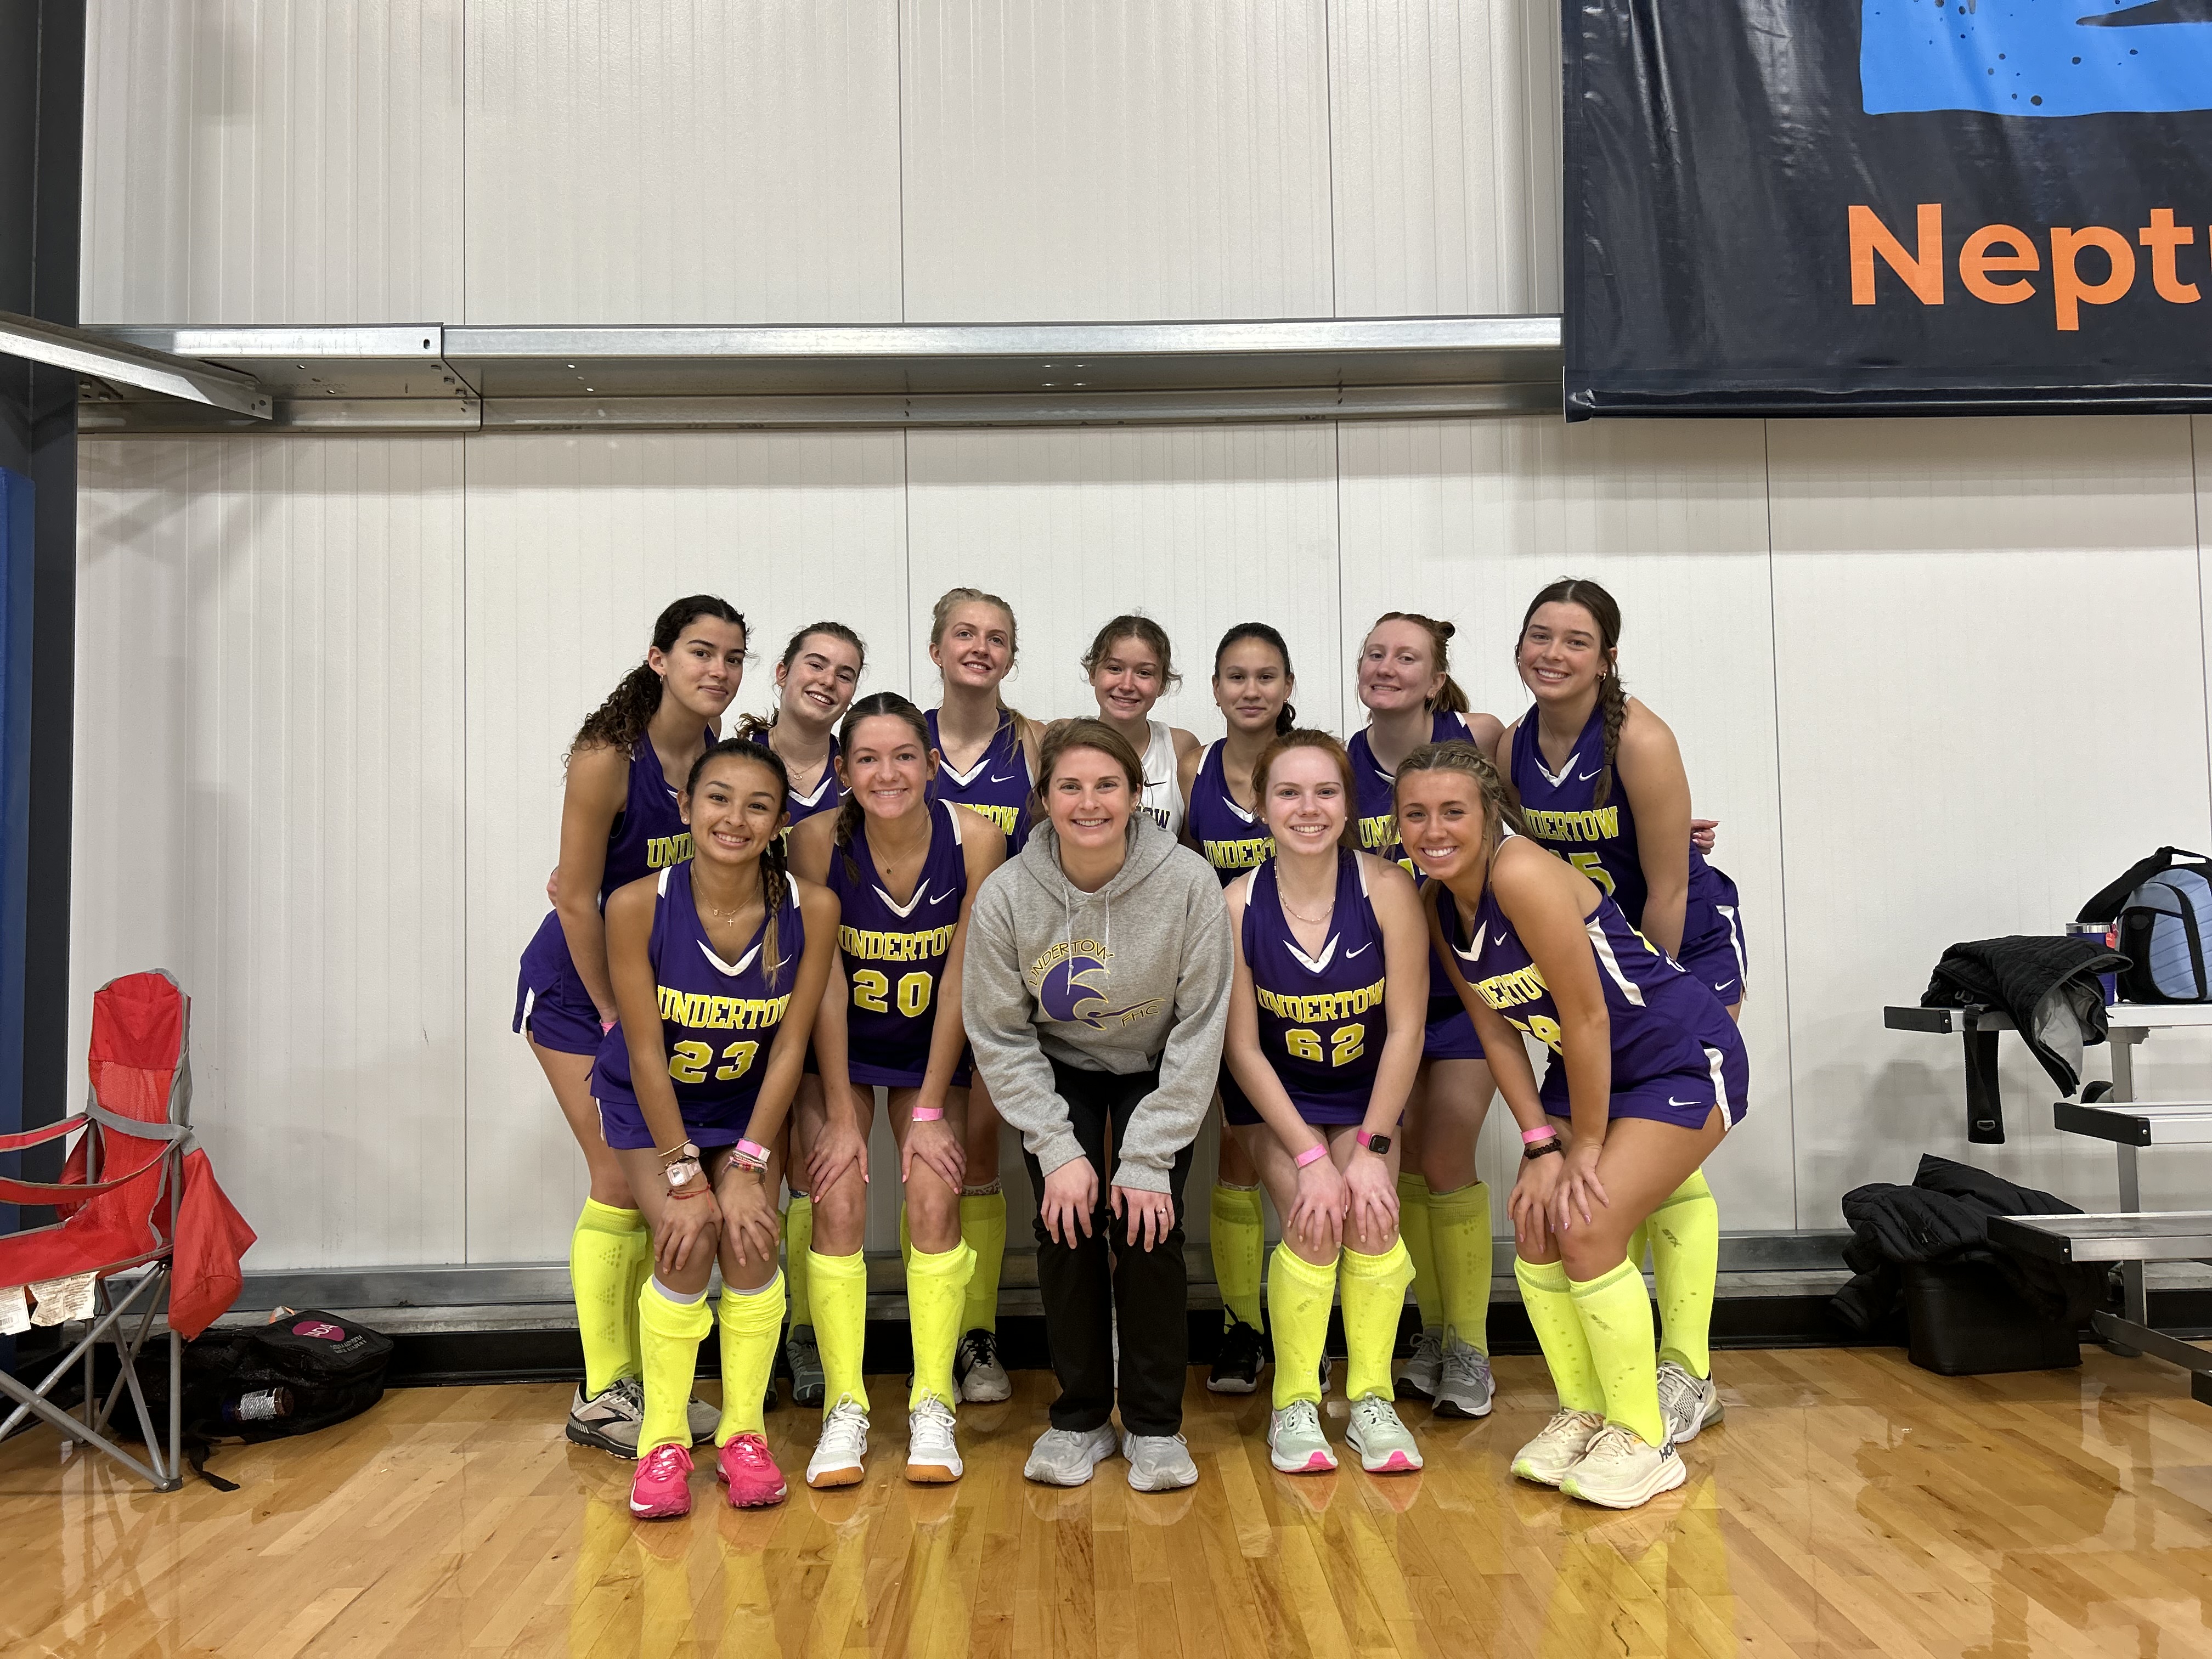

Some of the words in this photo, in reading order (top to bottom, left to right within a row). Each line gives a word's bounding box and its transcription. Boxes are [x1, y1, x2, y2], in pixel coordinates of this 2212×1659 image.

[1848, 203, 2212, 331] Nept
[1549, 848, 1616, 897] 5
[1029, 939, 1115, 986] UNDERTOW
[853, 968, 933, 1018] 20
[1121, 1005, 1159, 1028] FHC
[1256, 977, 1385, 1024] UNDERTOW
[668, 1040, 760, 1084] 23
[1285, 1023, 1365, 1068] 62
